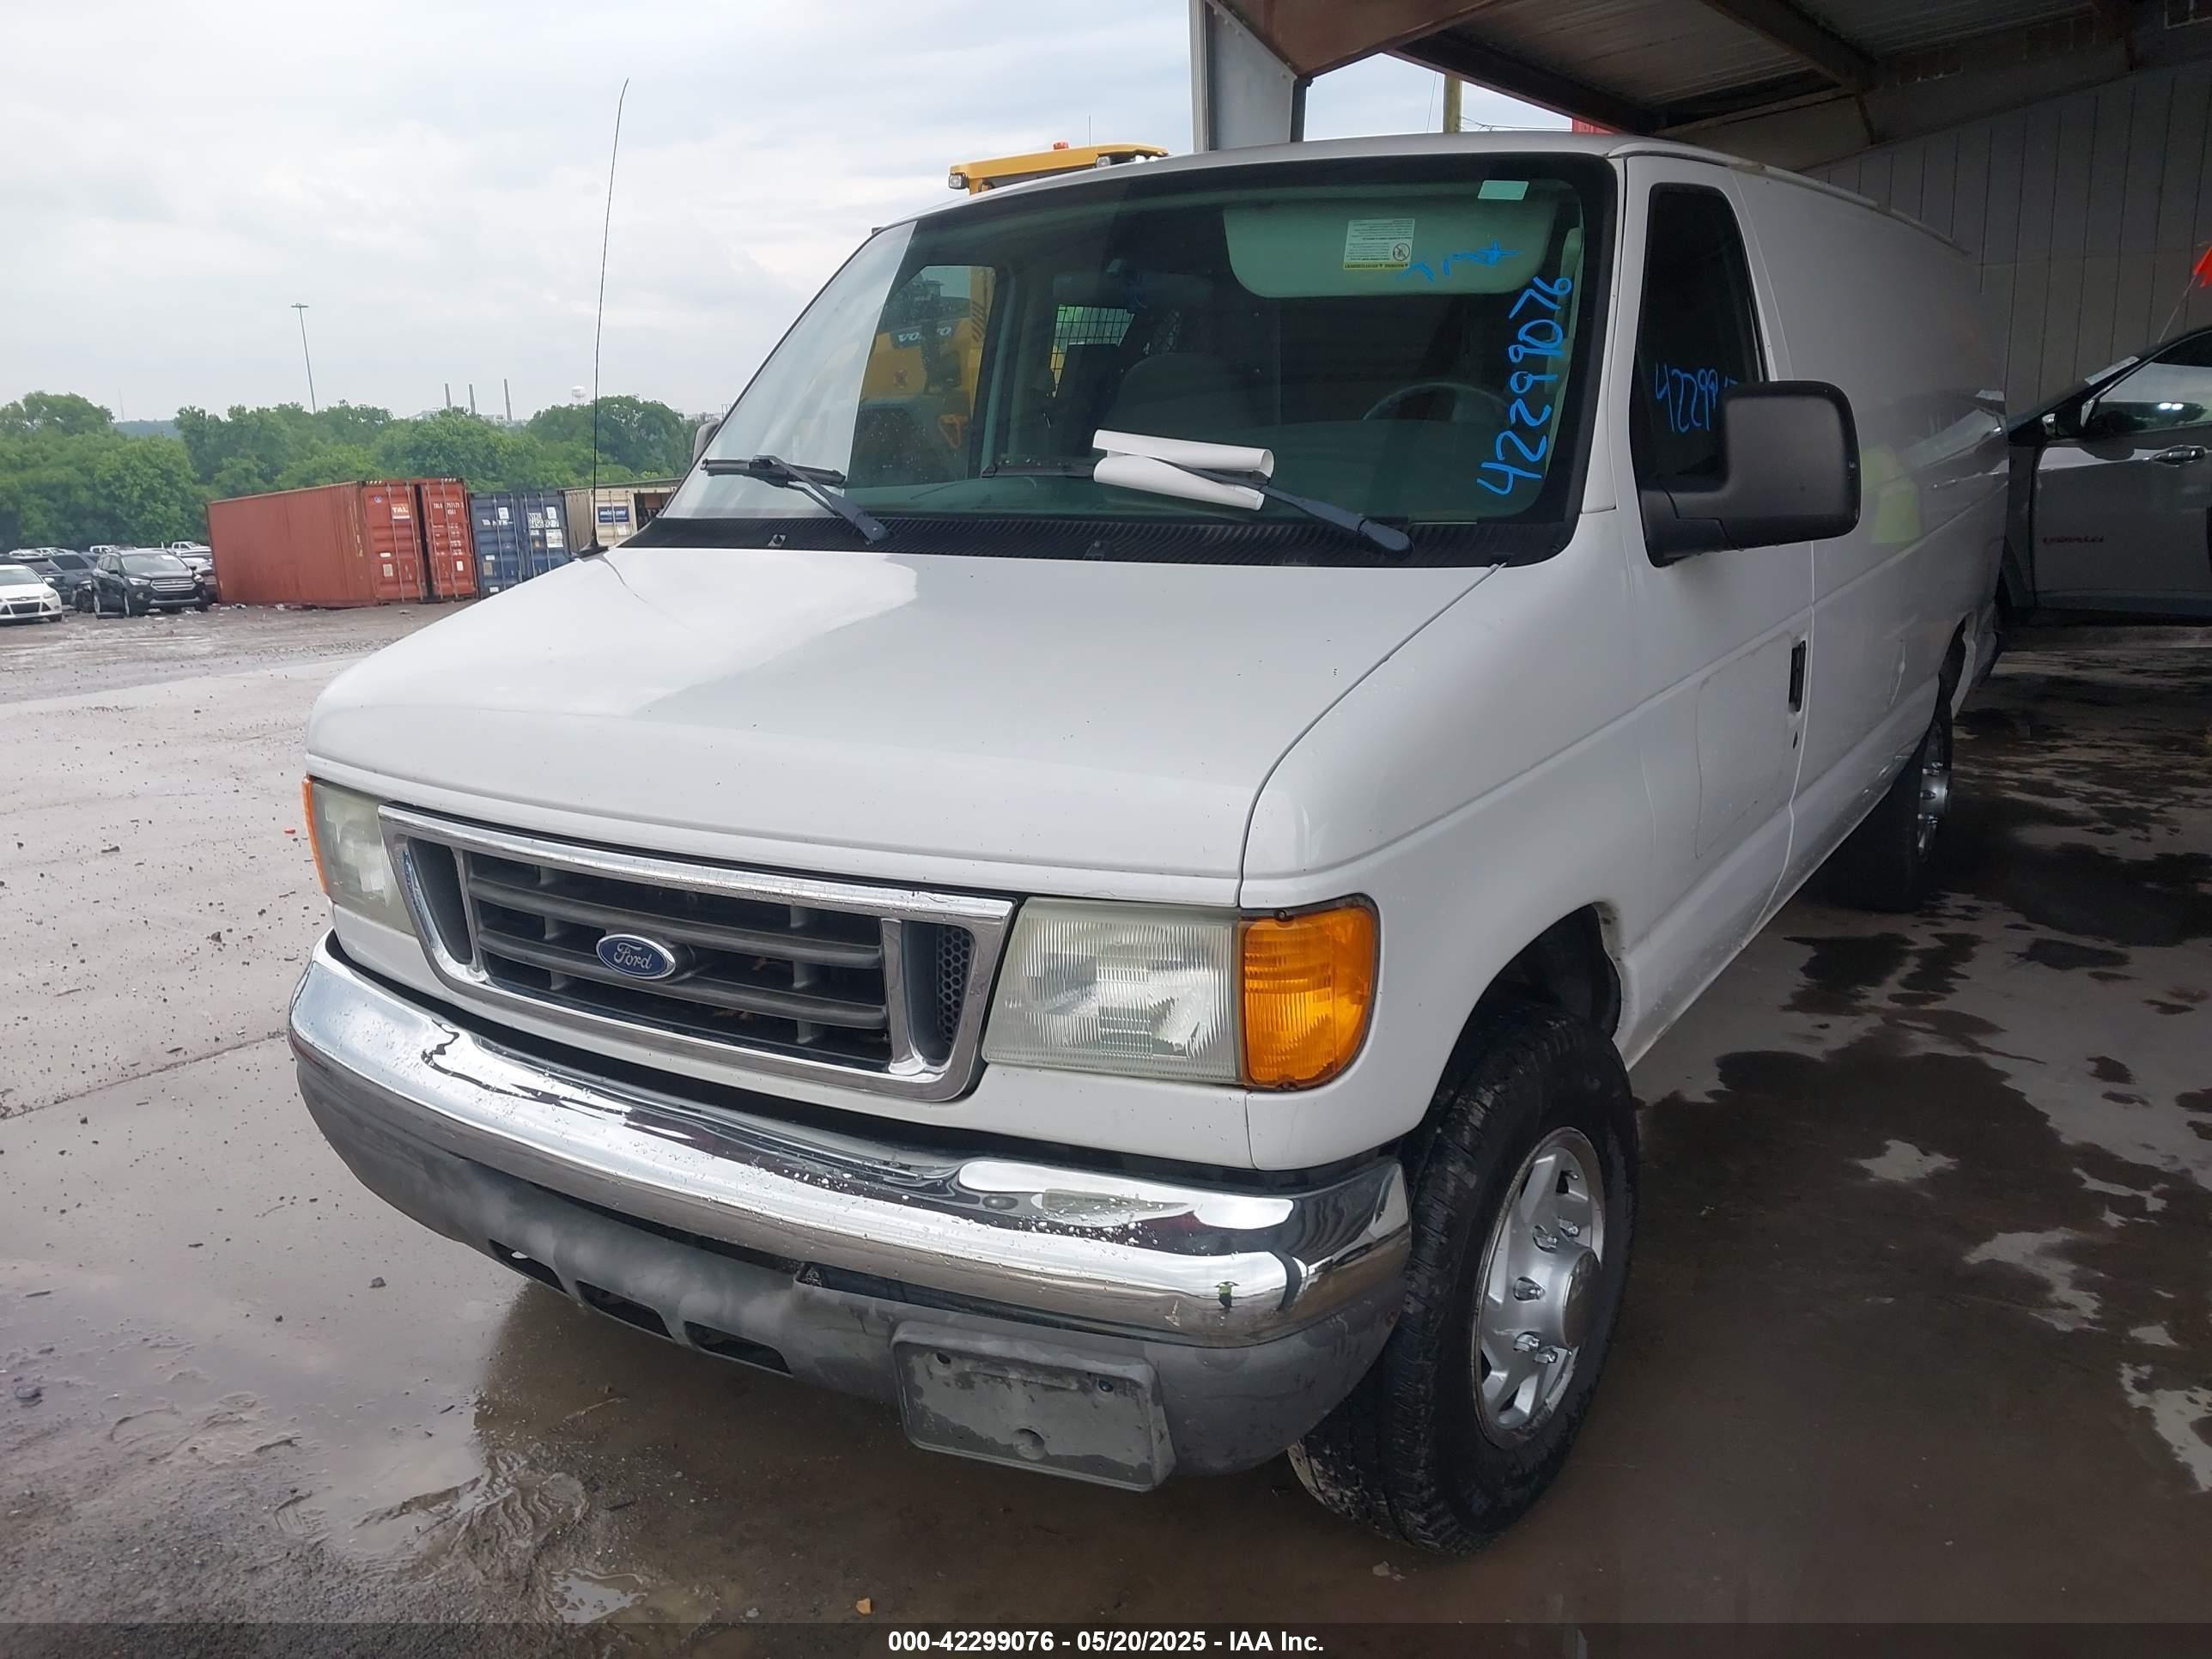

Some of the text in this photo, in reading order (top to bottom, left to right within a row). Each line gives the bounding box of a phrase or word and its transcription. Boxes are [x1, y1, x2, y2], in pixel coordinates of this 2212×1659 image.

[1476, 275, 1573, 496] 42299076
[1654, 362, 1740, 434] 42299
[613, 942, 653, 969] Ford
